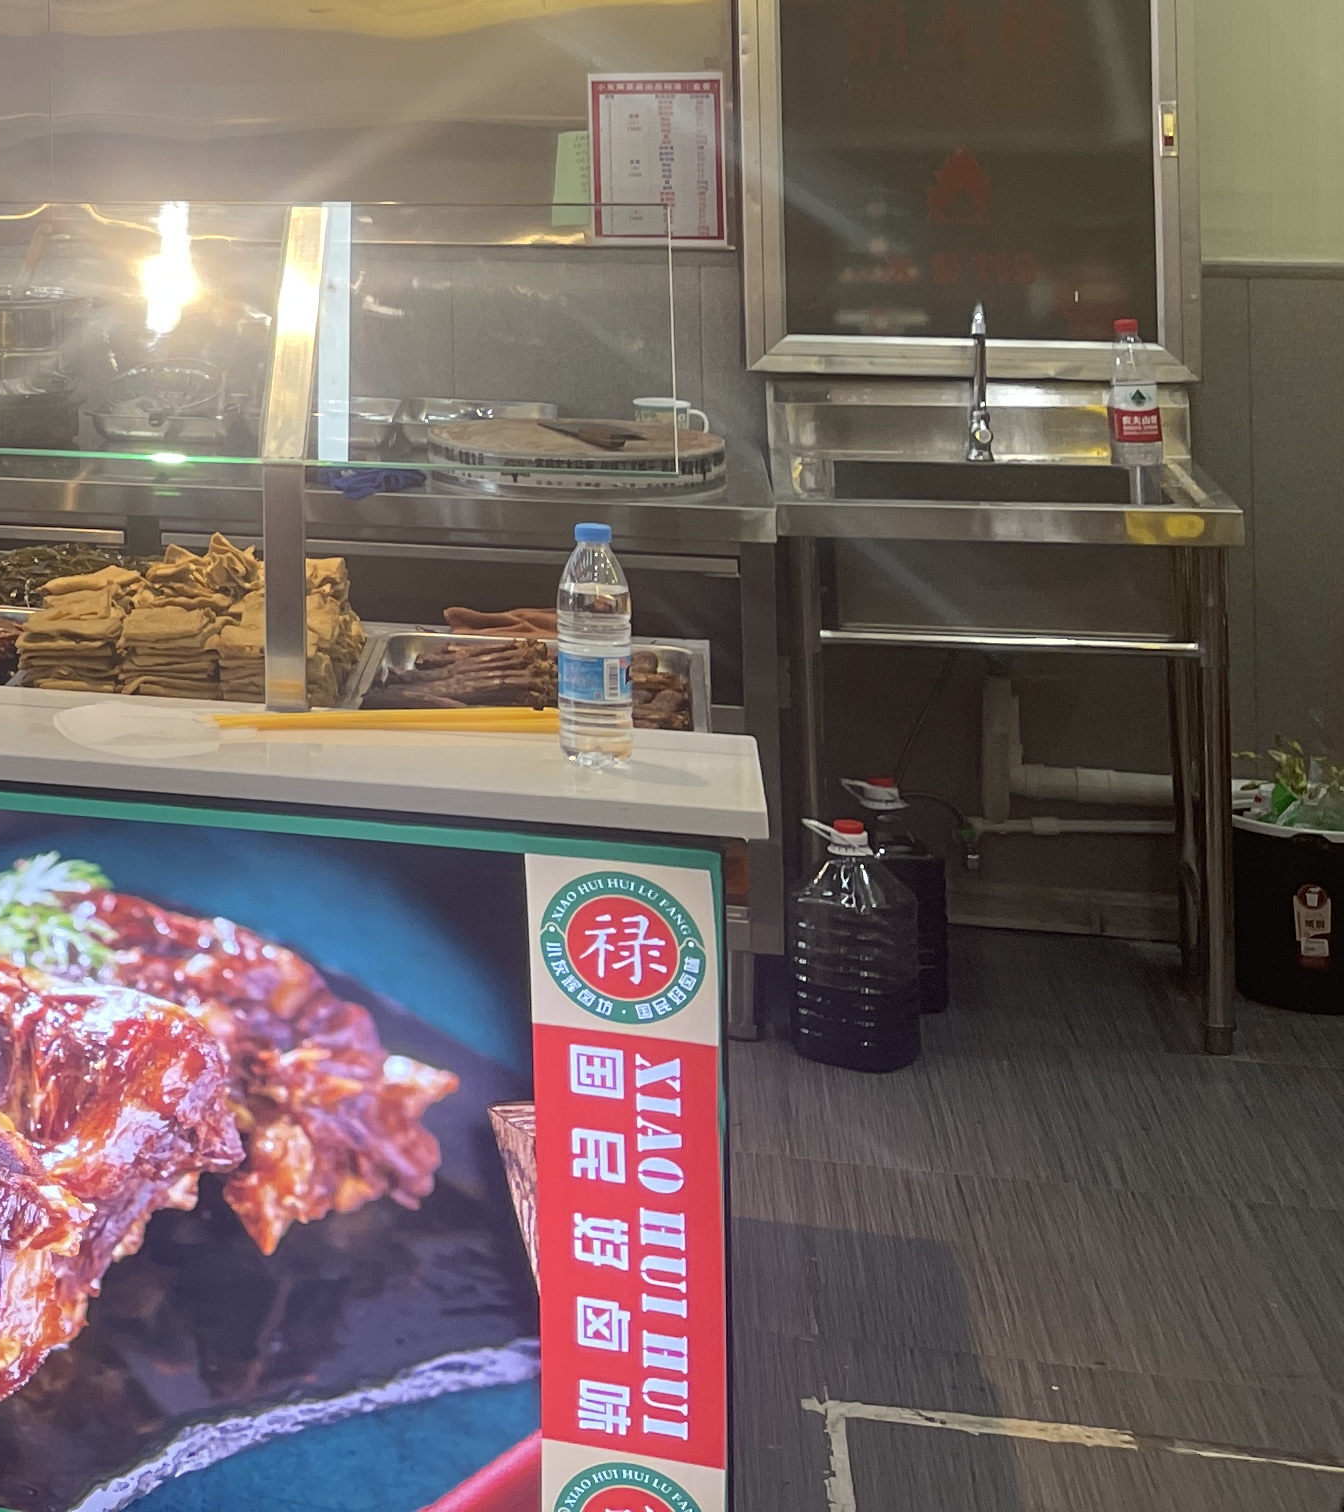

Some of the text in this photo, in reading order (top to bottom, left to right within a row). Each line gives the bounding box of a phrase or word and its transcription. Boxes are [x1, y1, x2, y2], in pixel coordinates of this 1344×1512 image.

[551, 878, 691, 936] XIAO HUI HUI LU FANG
[579, 914, 668, 985] 禄
[569, 1043, 631, 1436] 国民好卤味
[634, 1053, 689, 1441] XIAO HUI HUI
